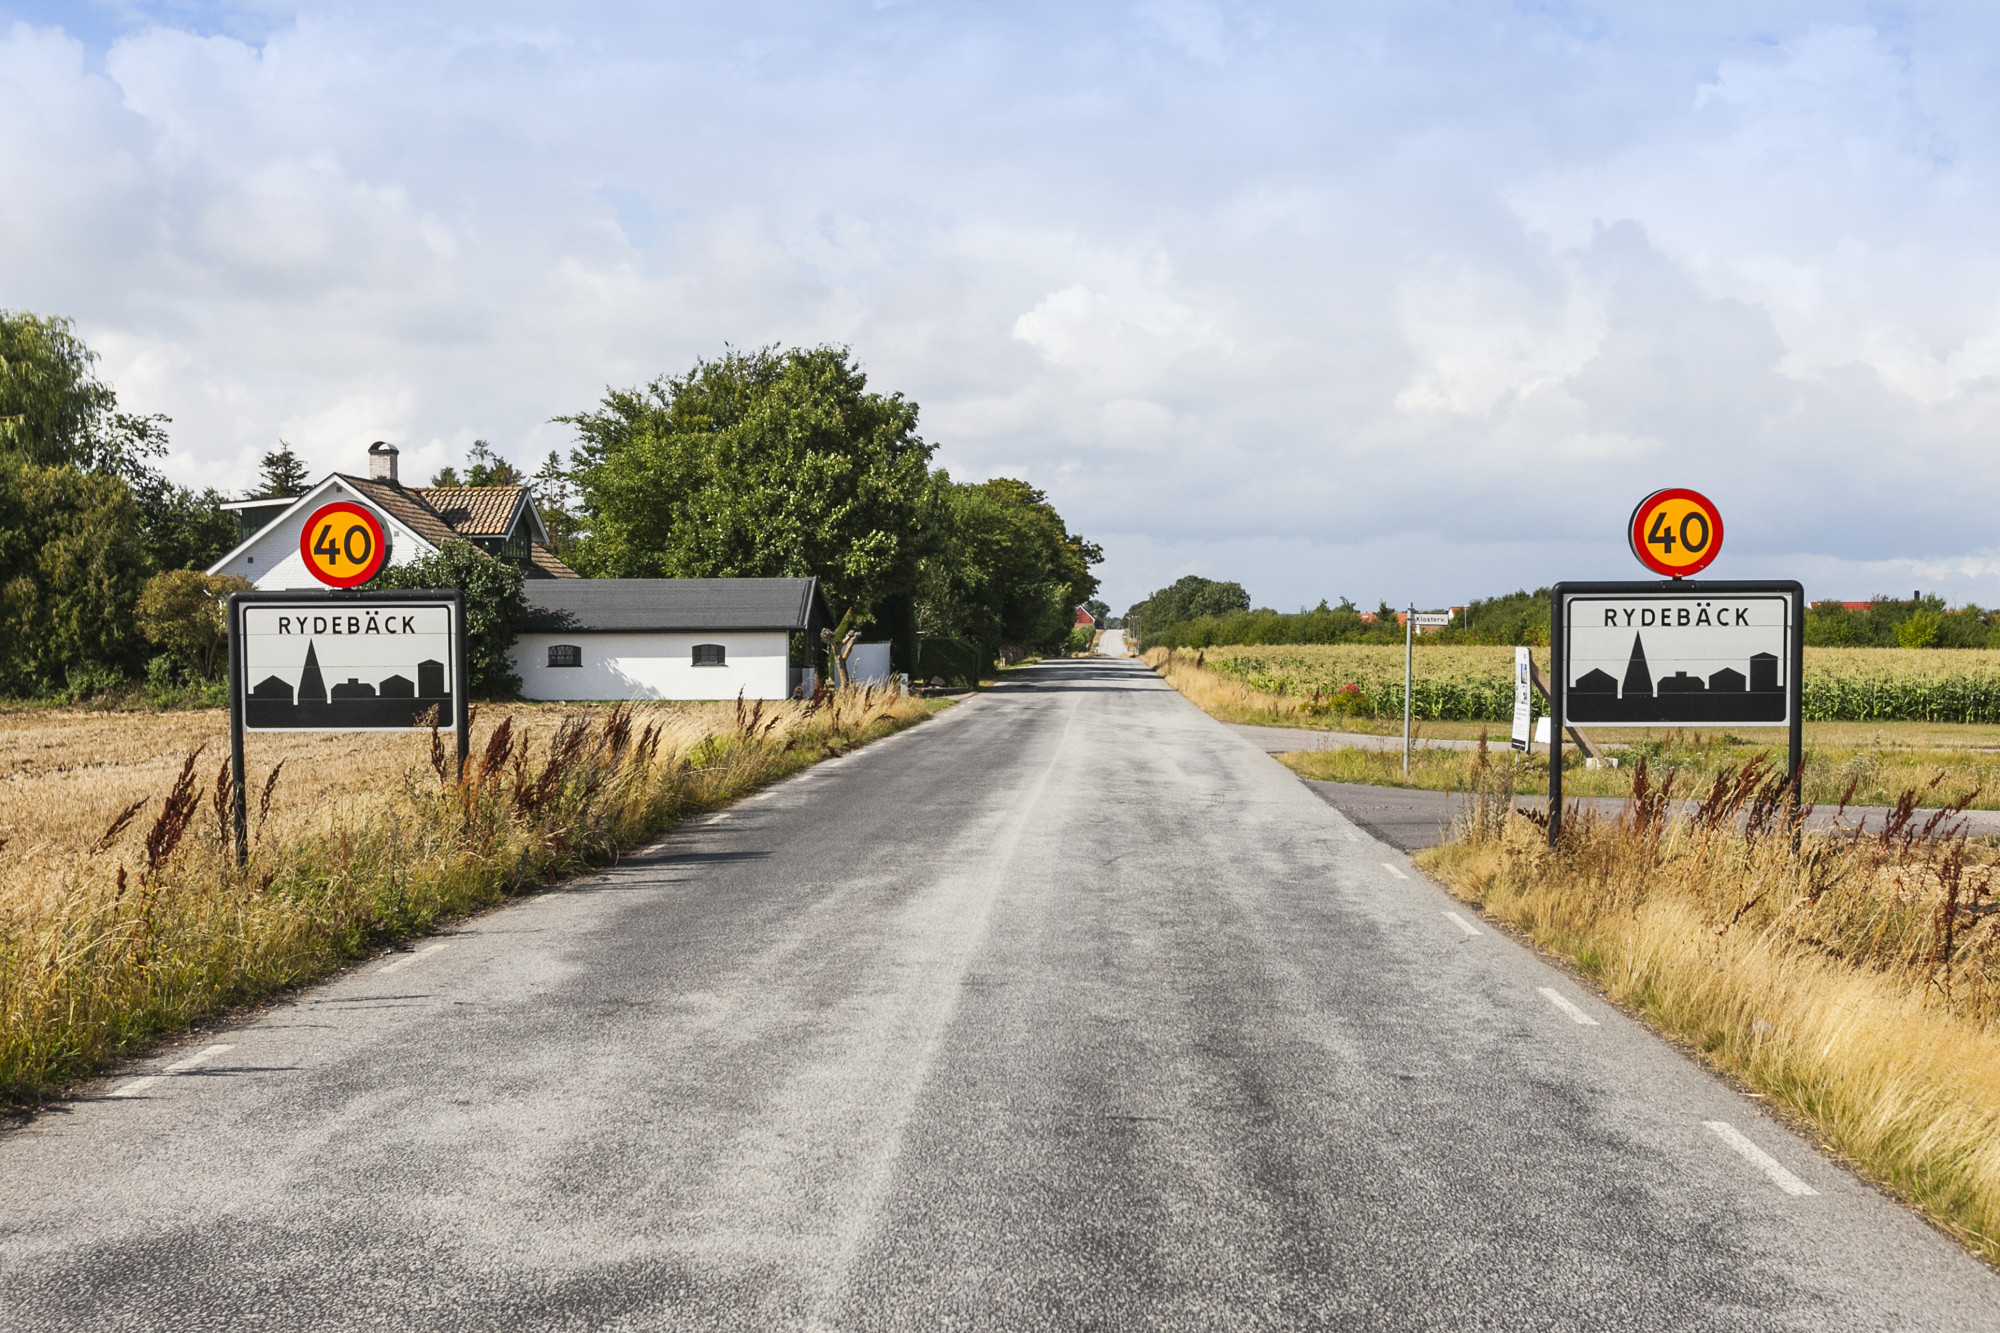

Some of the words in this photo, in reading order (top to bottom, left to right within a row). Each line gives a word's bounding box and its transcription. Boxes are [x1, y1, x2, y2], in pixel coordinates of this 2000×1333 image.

[313, 524, 372, 565] 40
[1647, 511, 1710, 554] 40
[278, 610, 416, 635] RYDEBÄCK
[1604, 602, 1750, 627] RYDEBÄCK
